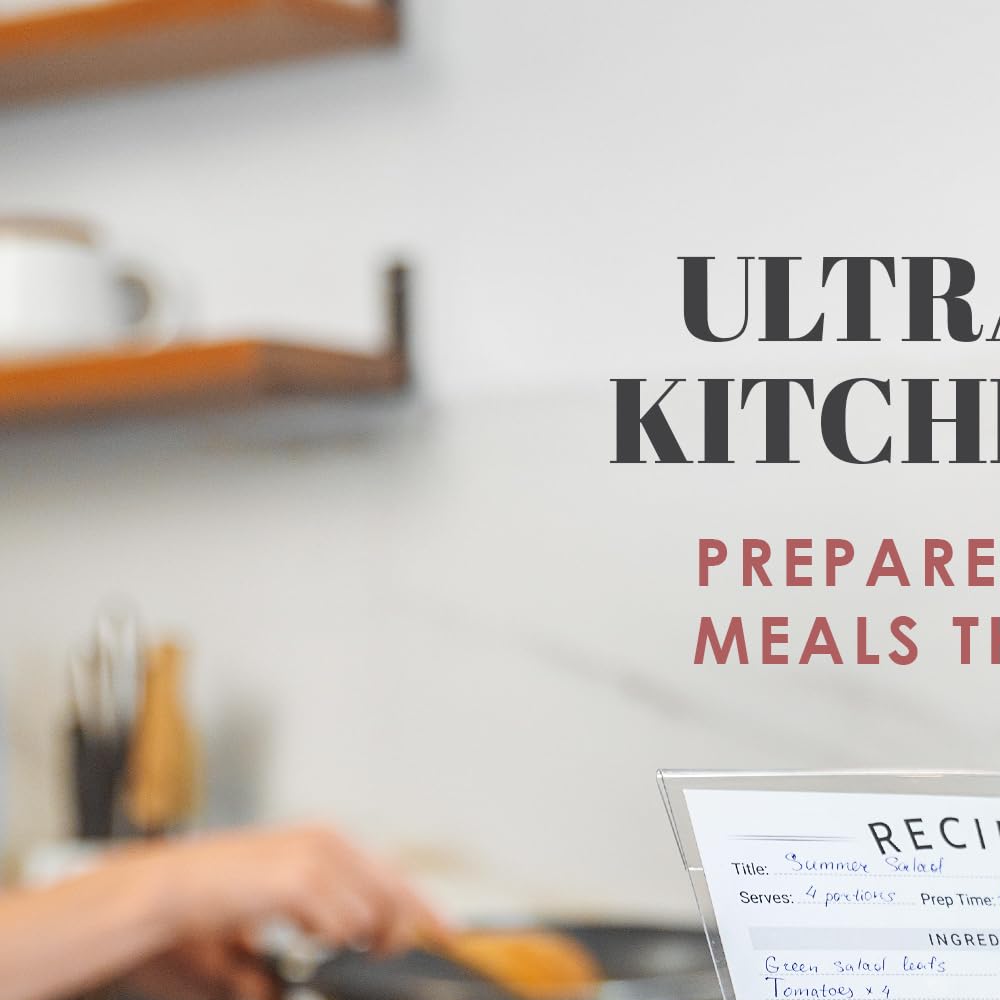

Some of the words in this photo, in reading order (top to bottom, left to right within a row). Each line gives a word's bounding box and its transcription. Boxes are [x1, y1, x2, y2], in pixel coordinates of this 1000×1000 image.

[731, 862, 769, 876] Title:
[785, 853, 869, 873] Summer
[885, 856, 944, 873] Salad
[739, 890, 794, 904] Serves:
[805, 885, 817, 899] 4
[825, 889, 896, 908] portions
[920, 892, 954, 908] Prep
[956, 893, 997, 907] Time:
[765, 955, 818, 974] Green
[833, 957, 886, 973] salad
[765, 976, 854, 999] Tomatoes
[882, 985, 891, 999] 4
